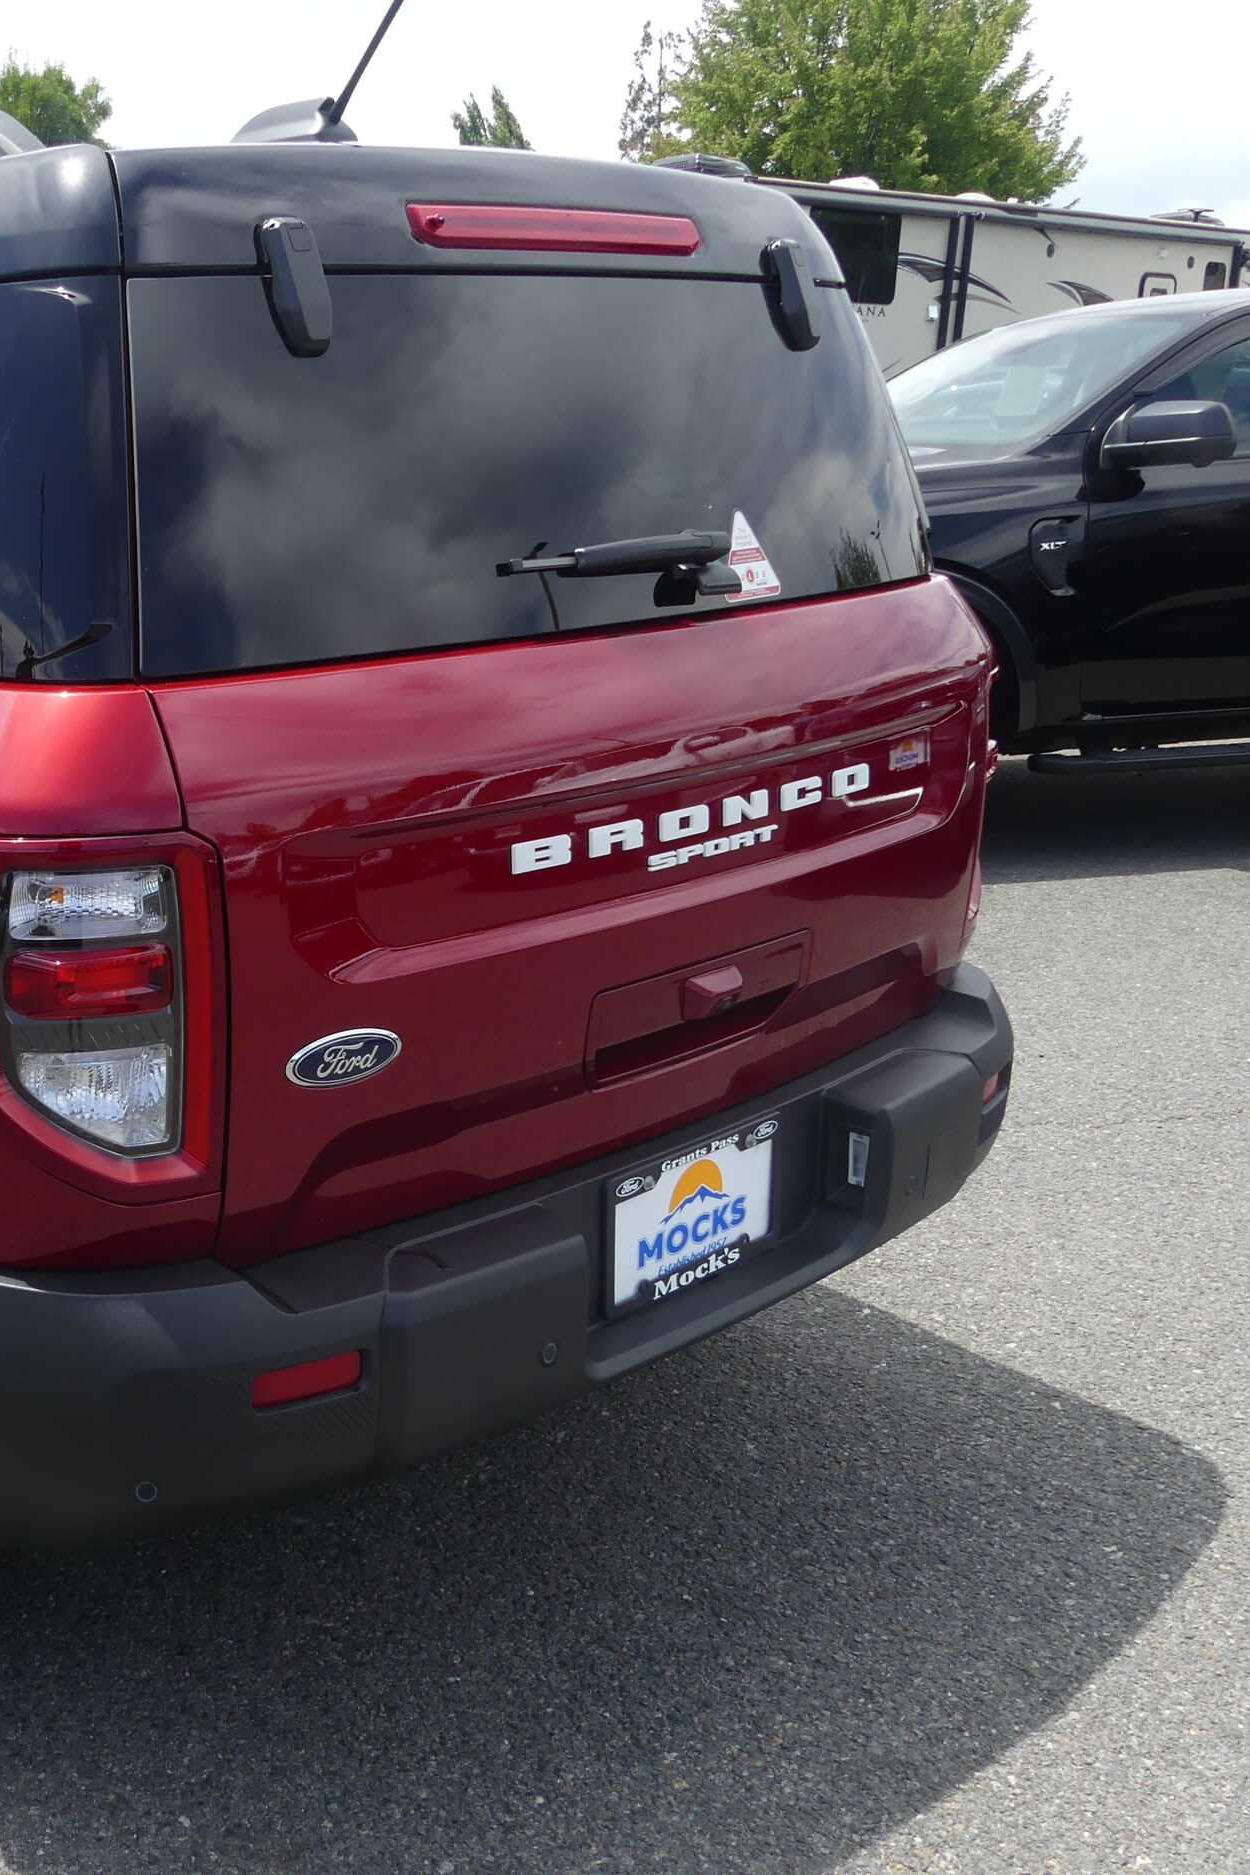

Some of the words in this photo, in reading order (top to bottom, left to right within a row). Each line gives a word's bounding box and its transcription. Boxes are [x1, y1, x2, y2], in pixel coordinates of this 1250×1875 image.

[1040, 541, 1067, 551] XLT
[511, 763, 870, 875] BRONCO
[647, 824, 778, 872] SPORT
[316, 1041, 379, 1078] Ford
[661, 1147, 708, 1173] Grants
[710, 1133, 739, 1153] Pass
[638, 1196, 746, 1270] MOCKS
[653, 1247, 740, 1300] Mock's
[657, 1245, 707, 1277] Established
[707, 1236, 727, 1256] 1957
